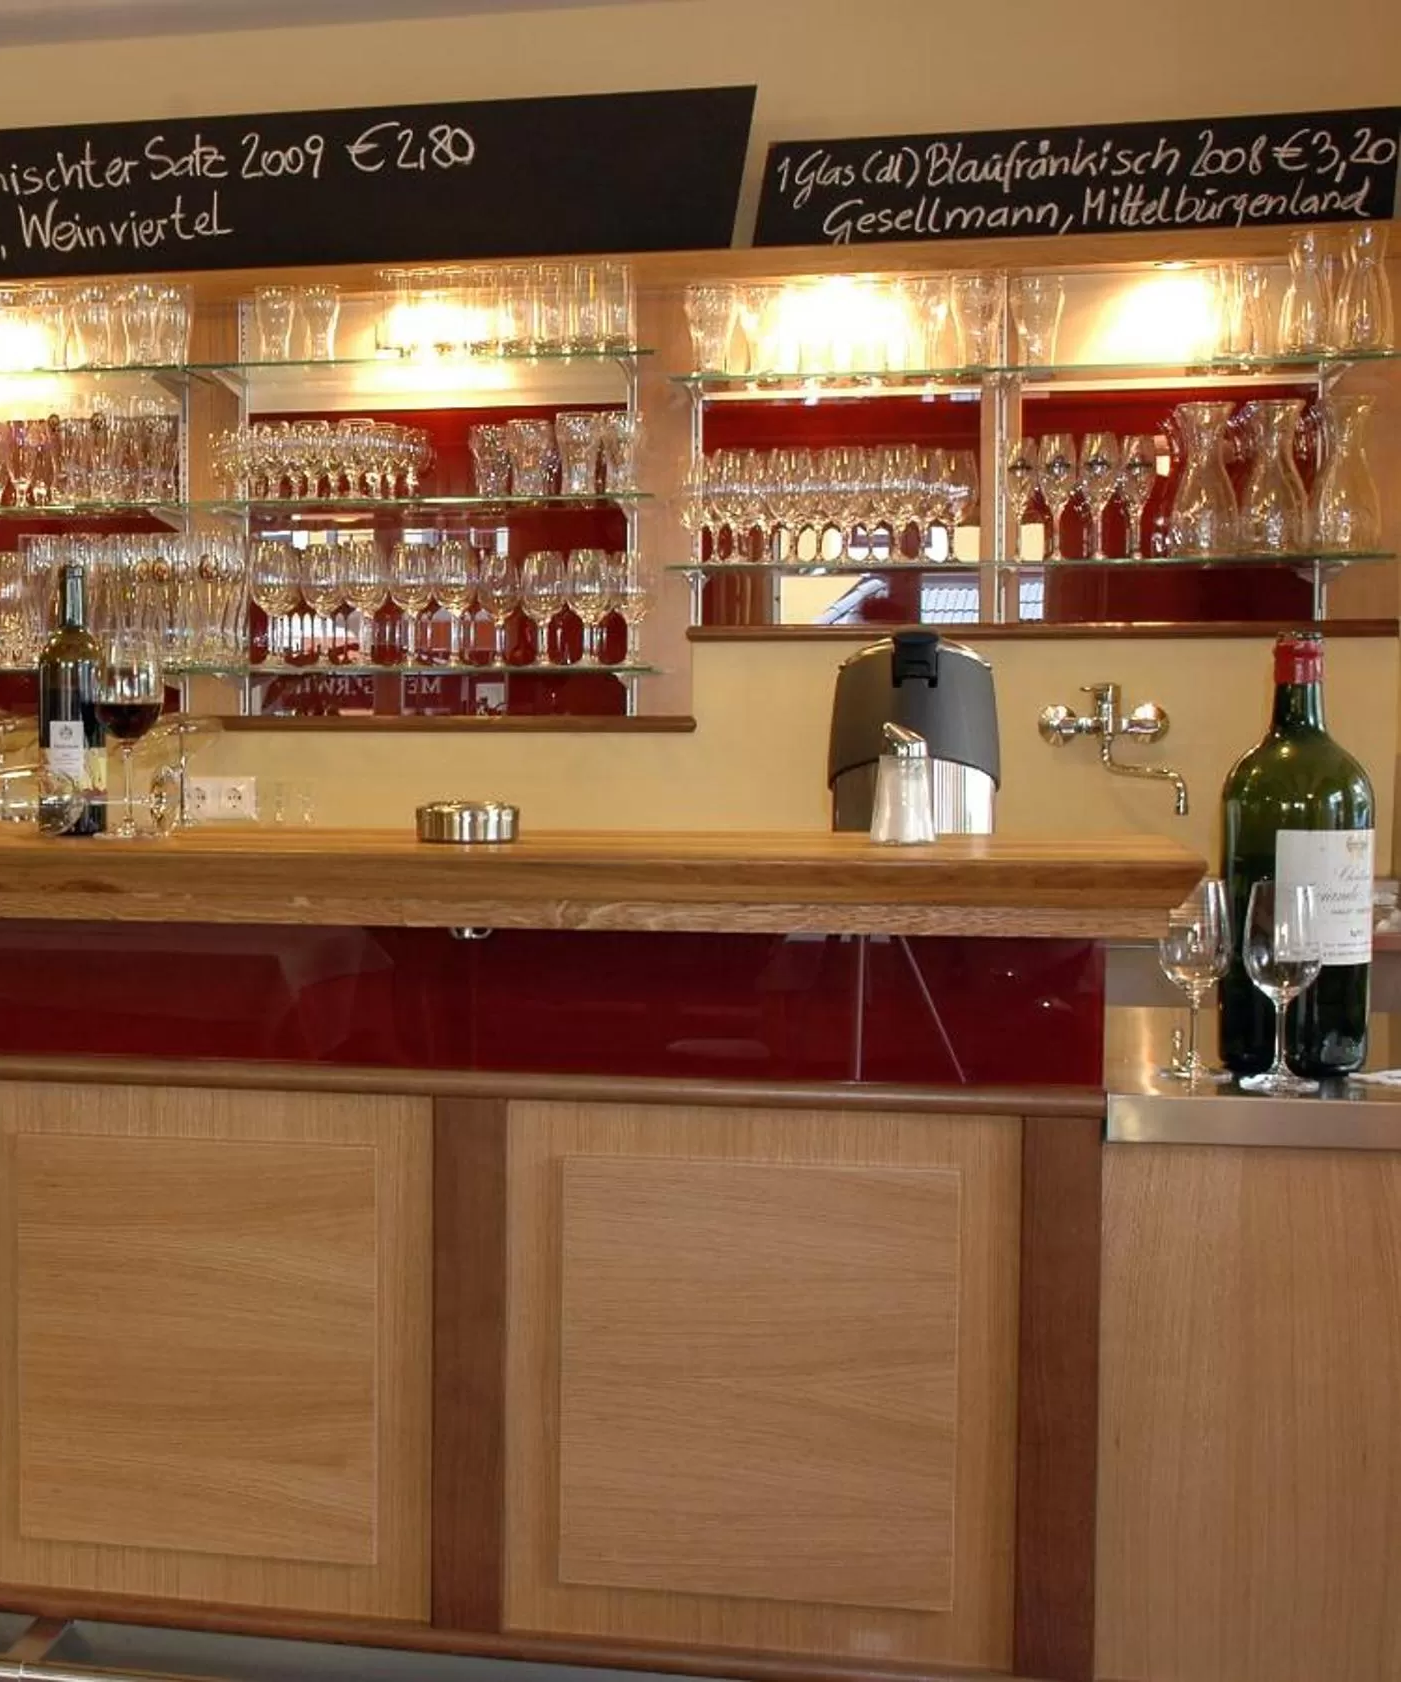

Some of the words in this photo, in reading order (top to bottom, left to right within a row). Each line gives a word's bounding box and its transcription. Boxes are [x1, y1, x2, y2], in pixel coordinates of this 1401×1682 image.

[145, 134, 229, 181] Satz
[241, 132, 325, 180] 2009
[778, 156, 790, 192] 1
[794, 150, 855, 210] Glas
[862, 147, 920, 189] (dl)
[926, 137, 1181, 193] Blaufränkisch
[1190, 128, 1267, 177] 2008
[1273, 127, 1396, 183] €3,20
[18, 190, 233, 252] Weinviertel
[822, 195, 1073, 245] Gesellmann,
